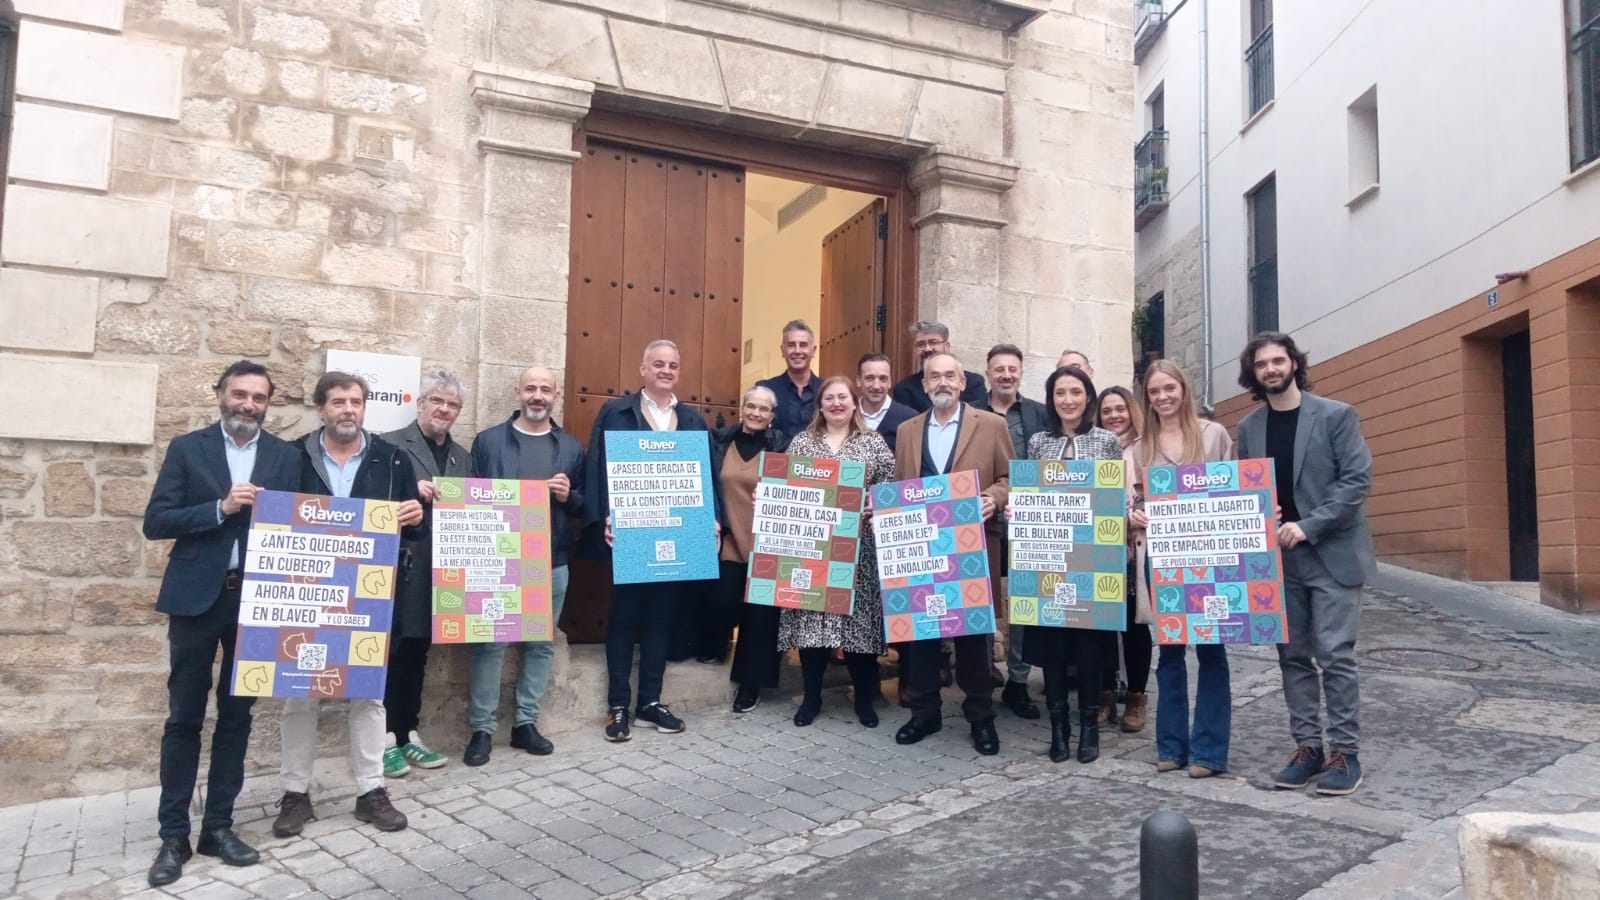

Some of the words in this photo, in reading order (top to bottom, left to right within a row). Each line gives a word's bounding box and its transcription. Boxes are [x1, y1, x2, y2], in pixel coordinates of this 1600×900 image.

[639, 440, 676, 450] Blaveo
[612, 464, 642, 474] ¿PASEO
[644, 464, 654, 474] DE
[657, 463, 684, 474] GRACIA
[687, 463, 696, 472] DE
[794, 464, 830, 477] Blaveo
[1046, 470, 1086, 482] Blaveo
[1183, 474, 1228, 488] Blaveo
[614, 480, 660, 490] BARCELONA
[662, 480, 668, 490] O
[670, 480, 694, 489] PLAZA
[471, 487, 512, 500] Blaveo
[764, 487, 770, 497] A
[772, 488, 798, 500] QUIEN
[800, 490, 820, 502] DIOS
[904, 487, 941, 500] Blaveo
[615, 497, 624, 507] DE
[627, 497, 637, 506] LA
[640, 494, 700, 506] CONSTITUCIÓN?
[1014, 495, 1056, 506] ¿CENTRAL
[1058, 496, 1086, 506] PARK?
[302, 505, 352, 522] Blaveo
[762, 504, 788, 516] QUISO
[790, 506, 812, 520] BIEN,
[815, 510, 837, 522] CASA
[1150, 502, 1196, 516] ¡MENTIRA!
[1199, 502, 1209, 514] EL
[1212, 499, 1254, 512] LAGARTO
[440, 511, 467, 520] RESPIRA
[880, 516, 903, 528] ¿ERES
[906, 513, 922, 524] MÁS
[1014, 512, 1041, 522] MEJOR
[1044, 512, 1053, 522] EL
[1056, 512, 1088, 524] PARQUE
[440, 522, 469, 532] SABOREA
[760, 522, 770, 532] LE
[773, 523, 787, 534] DIO
[790, 524, 800, 536] EN
[803, 525, 824, 538] JAÉN
[1152, 523, 1162, 534] DE
[1165, 522, 1176, 534] LA
[1179, 520, 1216, 533] MALENA
[1218, 515, 1260, 530] REVENTÓ
[450, 535, 466, 543] ESTE
[881, 532, 890, 543] DE
[893, 530, 914, 542] GRAN
[916, 527, 932, 538] EJE?
[1014, 528, 1029, 538] DEL
[1032, 528, 1068, 539] BULEVAR
[261, 534, 306, 550] ¿ANTES
[310, 538, 369, 554] QUEDABAS
[1152, 542, 1170, 552] POR
[1173, 539, 1216, 552] EMPACHO
[1218, 538, 1230, 549] DE
[1233, 536, 1260, 548] GIGAS
[440, 547, 486, 555] AUTENTICIDAD
[760, 546, 794, 556] ENCARGAMOS
[794, 550, 820, 558] NOSOTROS
[883, 550, 892, 560] ¿O
[896, 548, 906, 559] DE
[908, 546, 924, 557] AVD
[259, 556, 274, 570] EN
[278, 558, 330, 574] CUBERO?
[450, 559, 470, 567] MEJOR
[884, 564, 894, 576] DE
[896, 558, 944, 574] ANDALUCÍA?
[1170, 558, 1186, 566] PUSO
[1216, 556, 1236, 564] QUICO
[255, 584, 295, 600] AHORA
[298, 586, 344, 602] QUEDAS
[252, 607, 268, 620] EN
[272, 608, 316, 623] BLAVEO
[333, 616, 342, 624] LO
[344, 616, 366, 626] SABES
